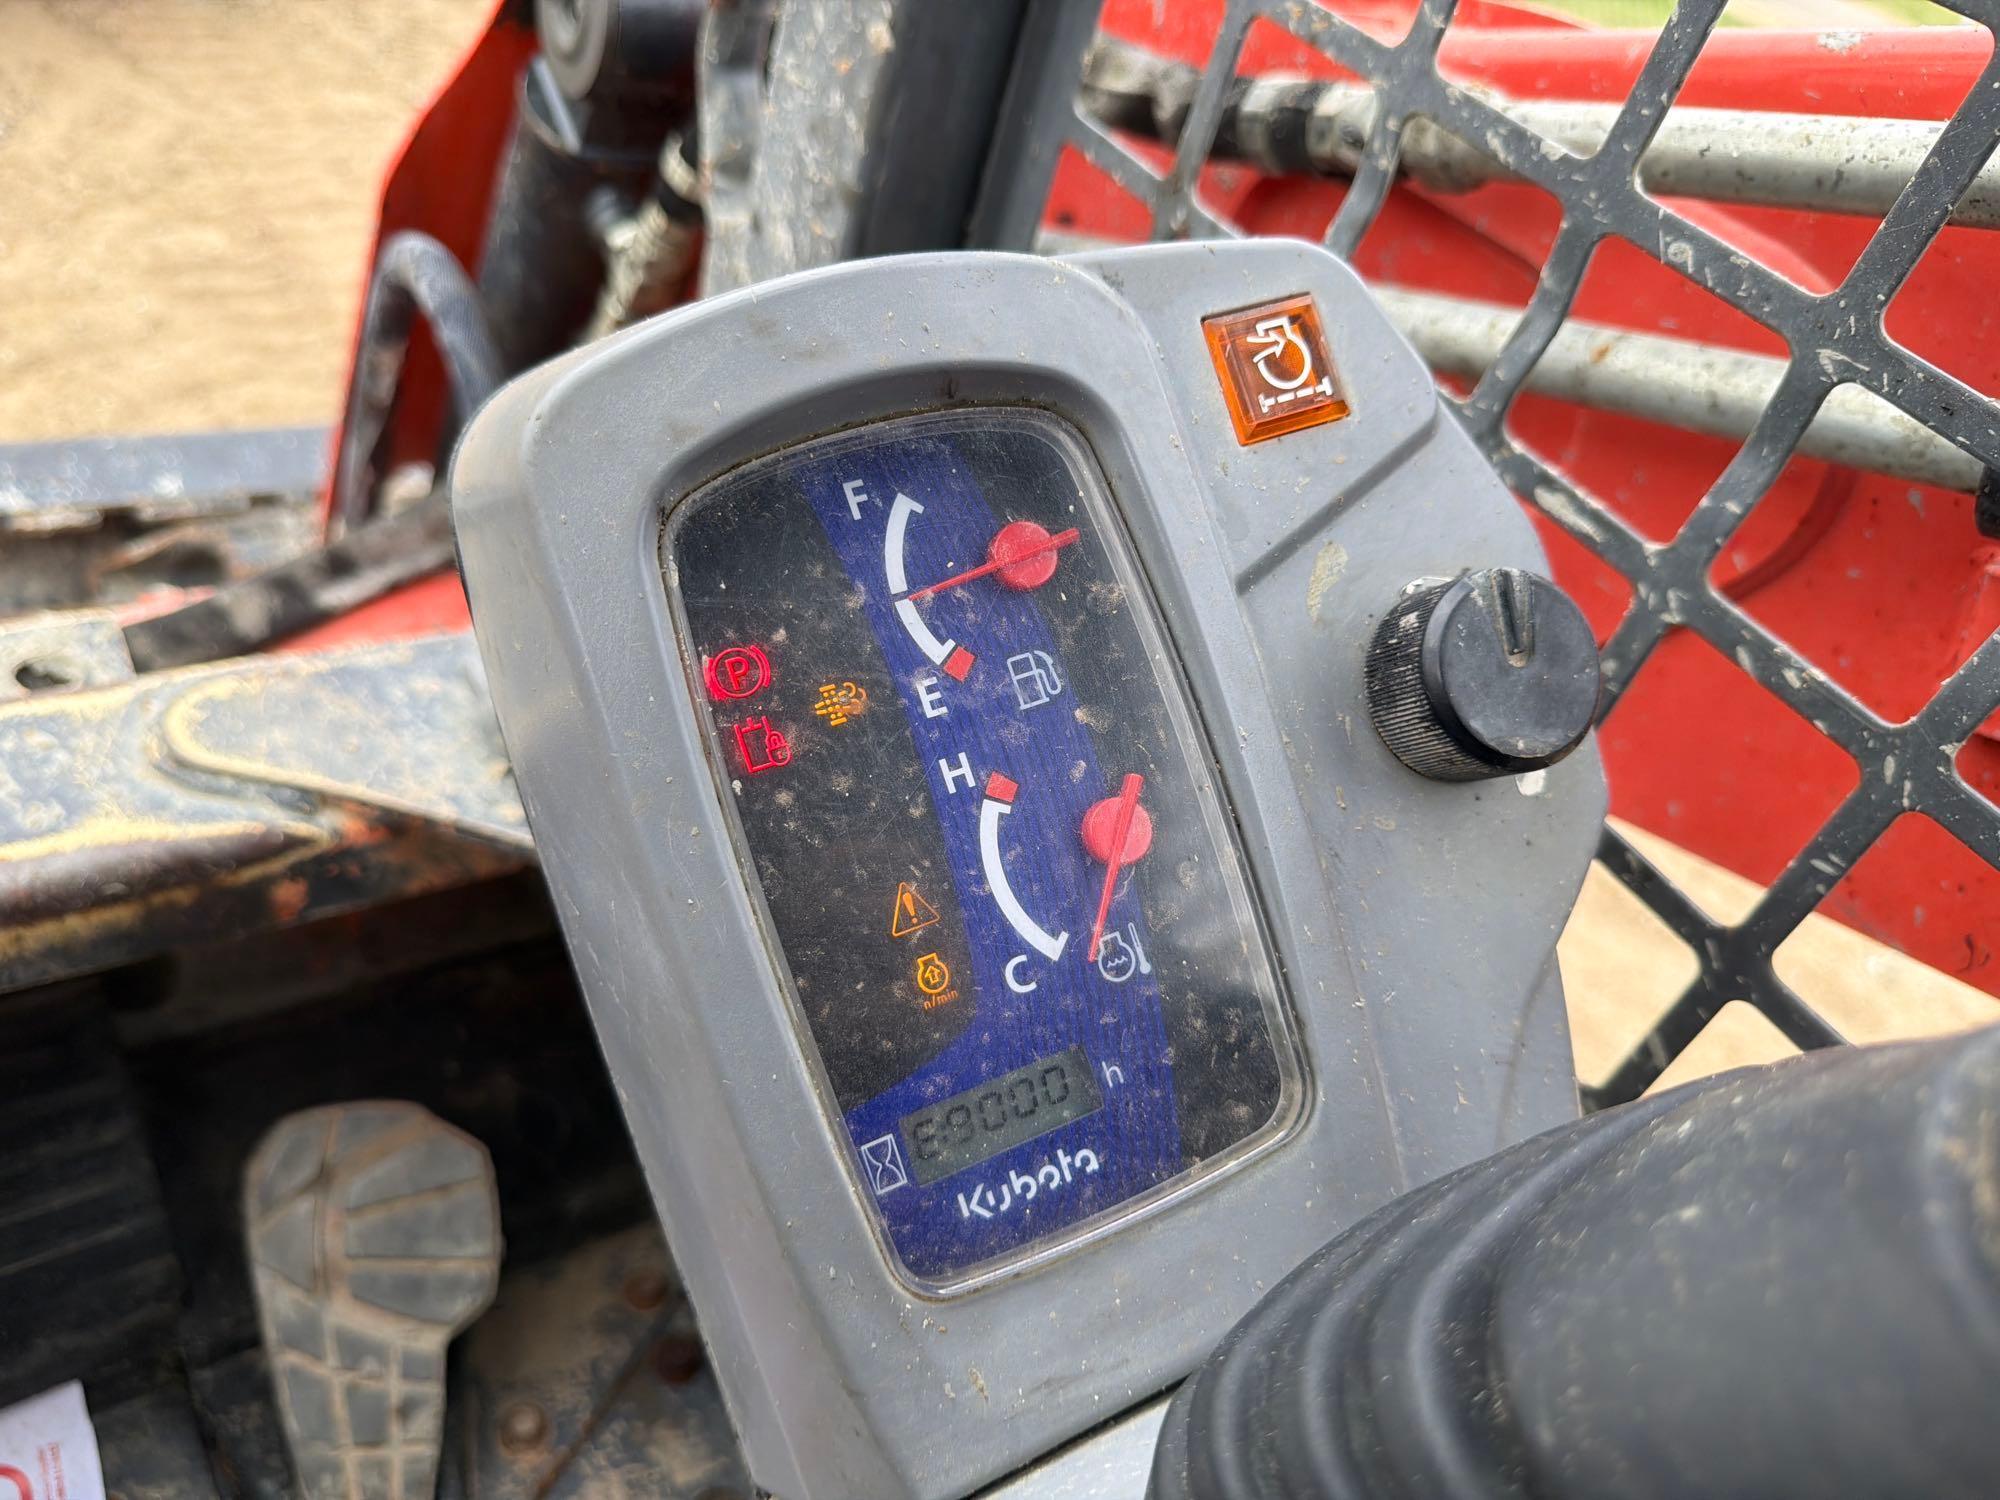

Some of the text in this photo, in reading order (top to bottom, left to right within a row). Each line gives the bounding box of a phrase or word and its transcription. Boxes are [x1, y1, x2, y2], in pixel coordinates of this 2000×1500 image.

[843, 479, 868, 520] F
[725, 656, 750, 691] P
[916, 677, 949, 718] E
[938, 752, 976, 794] H
[1004, 954, 1037, 993] C
[1101, 1061, 1125, 1088] h
[957, 1148, 1100, 1219] Kubota
